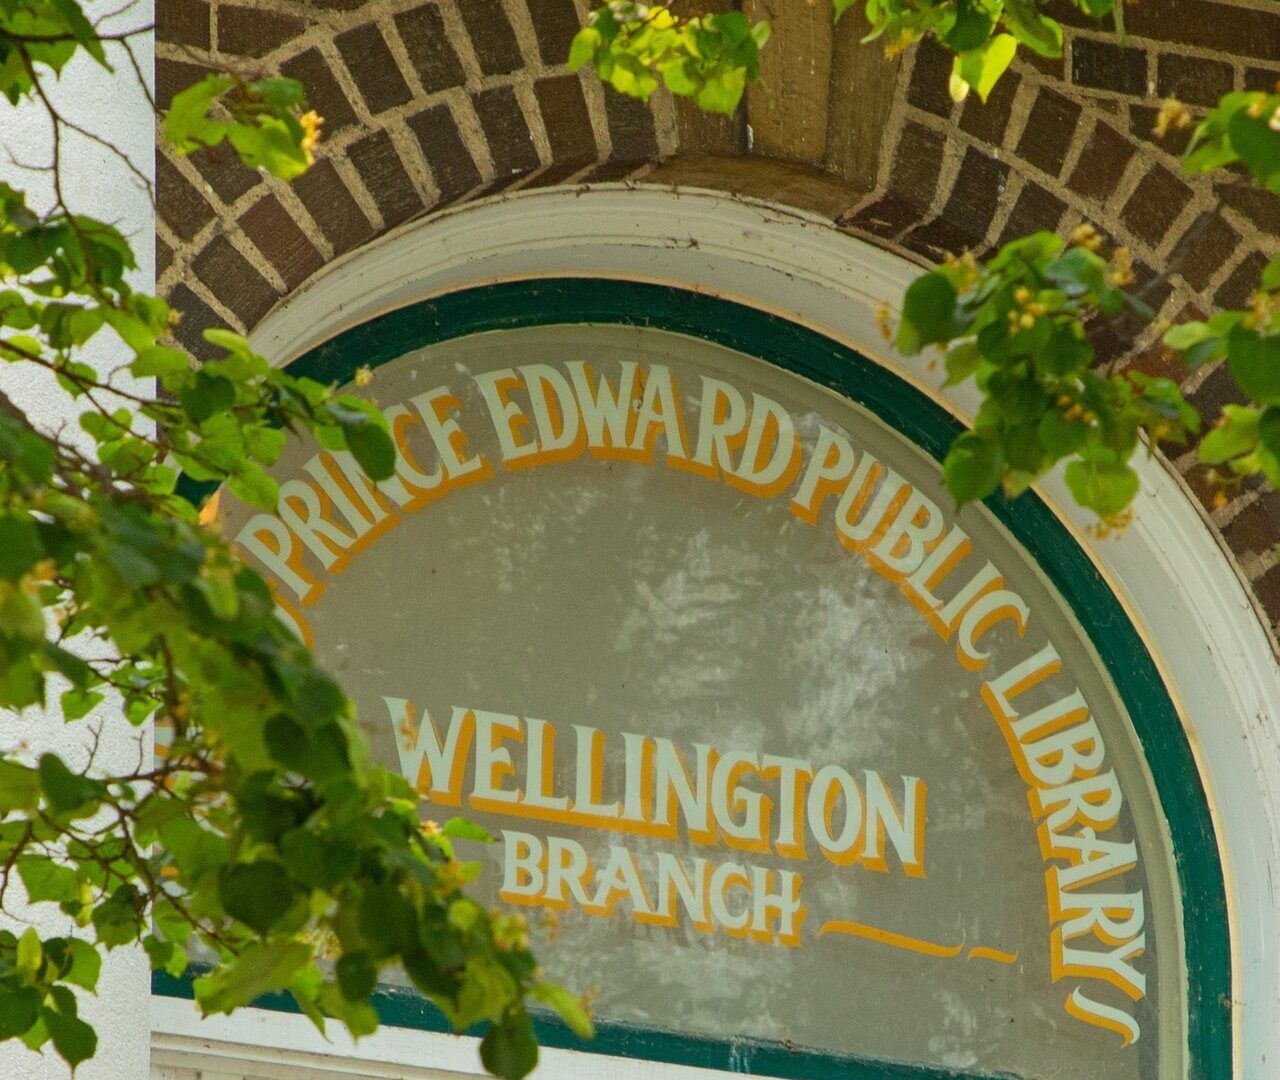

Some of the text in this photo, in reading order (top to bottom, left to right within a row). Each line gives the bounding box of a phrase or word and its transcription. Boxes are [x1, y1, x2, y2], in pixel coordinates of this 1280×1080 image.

[235, 360, 1148, 1001] PRINCE EDWARD PUBLIC LIBRARY
[381, 695, 927, 878] WELLINGTON
[499, 829, 803, 947] BRANCH
